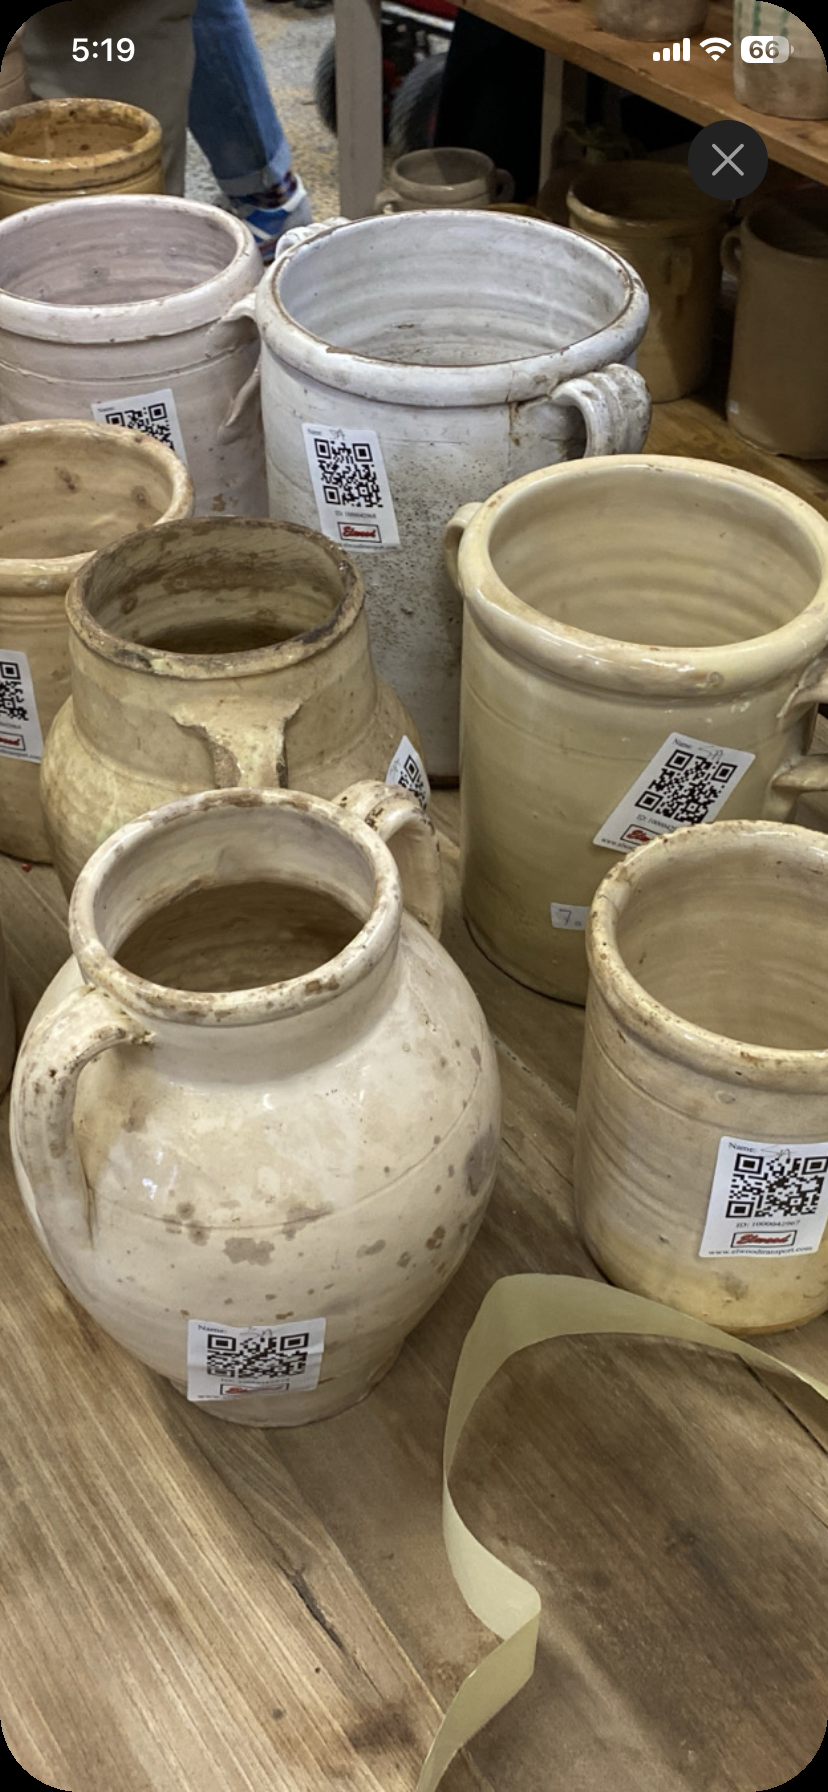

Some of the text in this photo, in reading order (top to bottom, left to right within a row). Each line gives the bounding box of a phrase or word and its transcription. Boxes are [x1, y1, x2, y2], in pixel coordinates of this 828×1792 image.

[729, 1142, 757, 1153] Name:
[736, 1233, 791, 1245] Elwood
[198, 1324, 228, 1334] Name:
